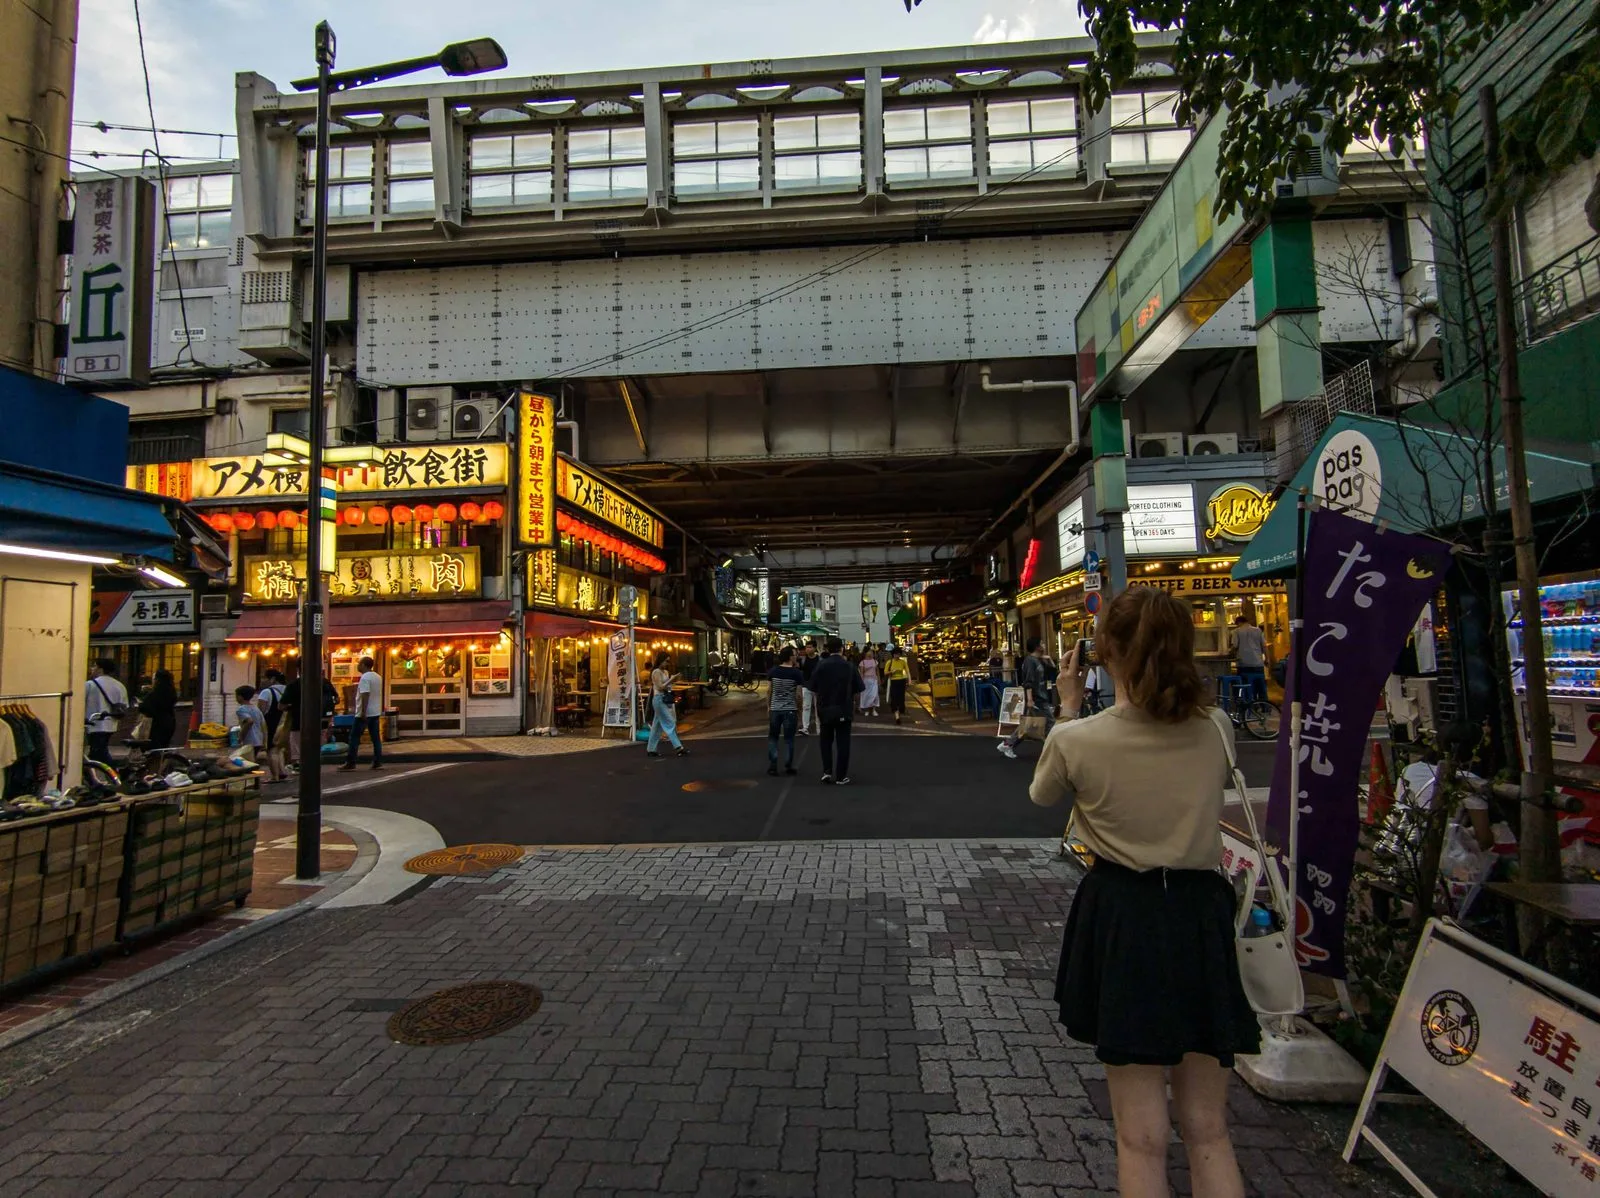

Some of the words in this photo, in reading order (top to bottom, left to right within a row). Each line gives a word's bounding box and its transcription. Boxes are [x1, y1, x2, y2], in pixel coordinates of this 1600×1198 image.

[93, 189, 113, 256] 純喫茶
[72, 262, 126, 344] 丘
[528, 396, 545, 543] 昼から朝まで営業中
[1323, 444, 1363, 484] pas
[571, 473, 650, 540] アメ横ガード下飲食街
[1152, 501, 1182, 509] CLOTHING
[1132, 528, 1148, 537] OPEN
[1148, 528, 1159, 537] 365
[1159, 528, 1175, 536] DAYS
[430, 552, 465, 593] 肉
[1128, 578, 1185, 590] COFFEE
[1191, 577, 1231, 590] BEER
[131, 600, 190, 620] 居酒屋
[1517, 1060, 1600, 1125] 放置自
